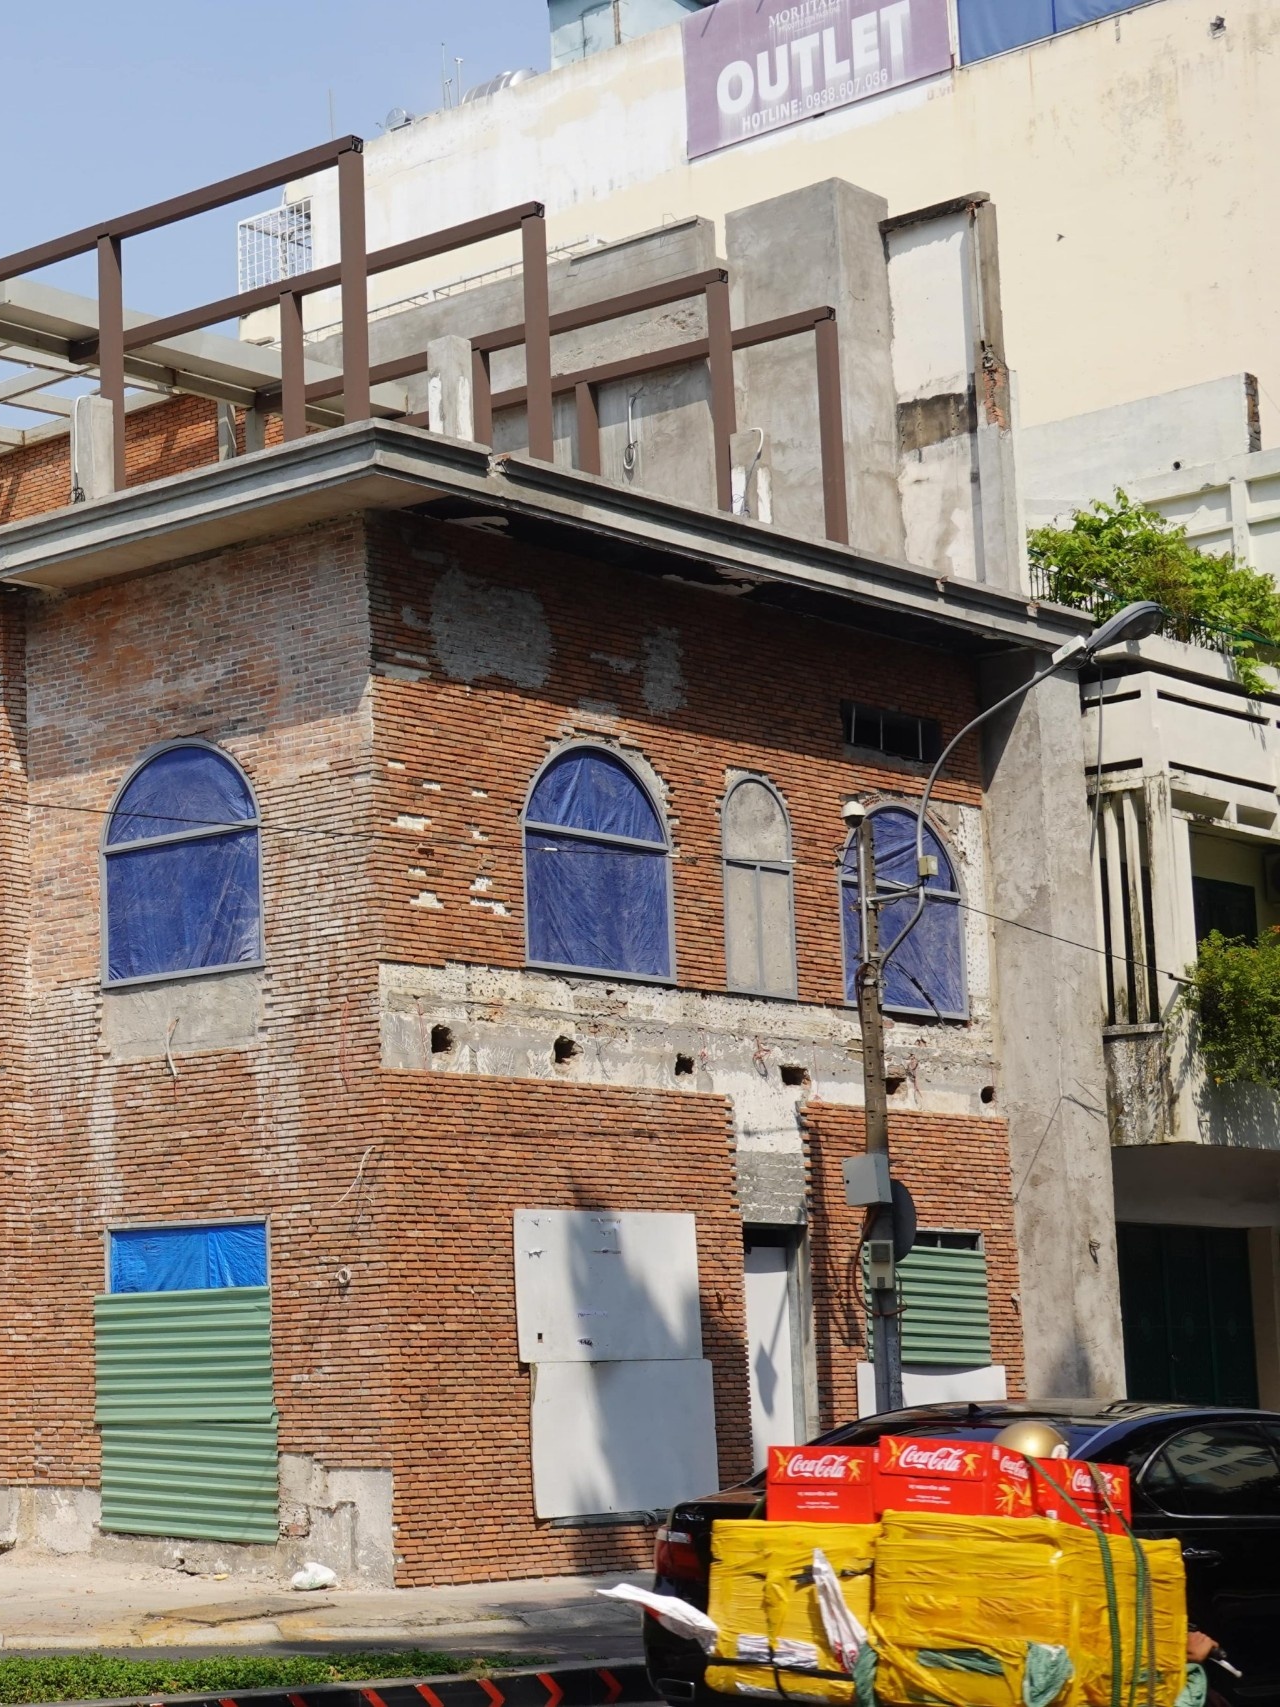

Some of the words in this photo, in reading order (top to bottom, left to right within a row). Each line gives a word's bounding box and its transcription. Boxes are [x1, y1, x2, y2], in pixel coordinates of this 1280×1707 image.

[716, 0, 911, 115] OUTLET
[742, 98, 803, 133] HOTLINE:
[806, 68, 888, 109] 0938.607.036
